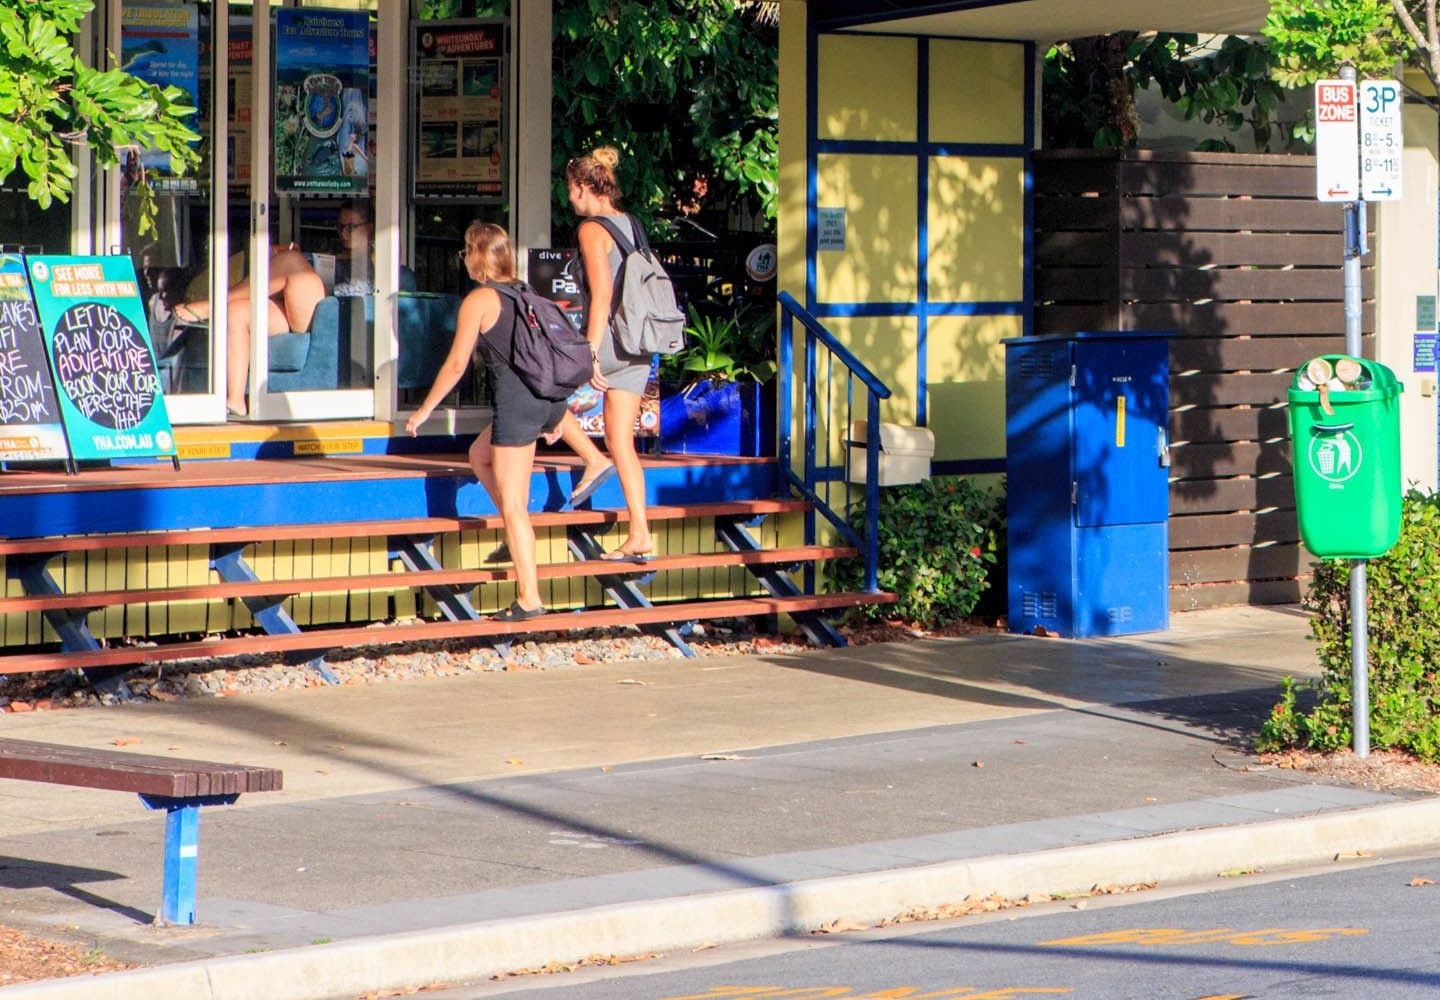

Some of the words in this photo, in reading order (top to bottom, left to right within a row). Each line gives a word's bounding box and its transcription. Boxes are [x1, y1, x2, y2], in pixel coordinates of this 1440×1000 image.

[1322, 87, 1350, 103] BUS
[1366, 86, 1396, 113] 3P
[1320, 104, 1354, 120] ZONE
[539, 251, 562, 260] dive
[54, 267, 74, 281] SEE
[75, 265, 102, 280] MORE
[65, 304, 95, 331] LET
[97, 306, 121, 330] US
[54, 328, 92, 354] PLAN
[96, 326, 144, 352] YOUR
[59, 348, 151, 387] ADVENTURE
[64, 373, 104, 399] BOOK
[98, 369, 138, 399] YOUR
[78, 394, 113, 419] HERE
[92, 434, 152, 450] YHA.COM.AU
